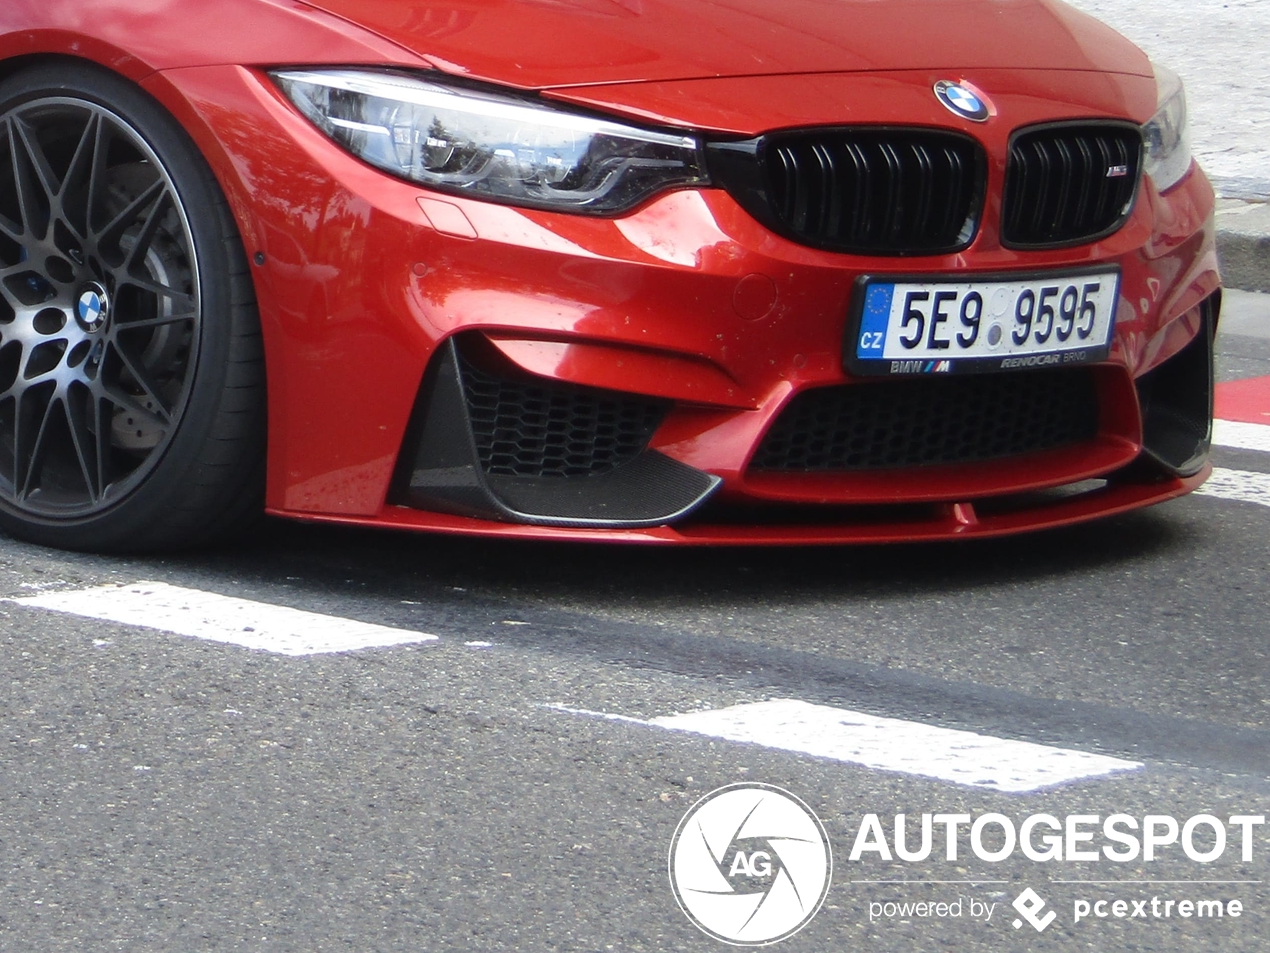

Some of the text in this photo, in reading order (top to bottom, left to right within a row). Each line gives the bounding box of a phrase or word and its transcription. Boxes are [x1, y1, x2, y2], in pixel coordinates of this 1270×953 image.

[899, 283, 1100, 349] 5E9 9595
[861, 332, 882, 348] CZ
[890, 361, 950, 373] BMW M
[1000, 351, 1086, 368] RENOCAR BRNO
